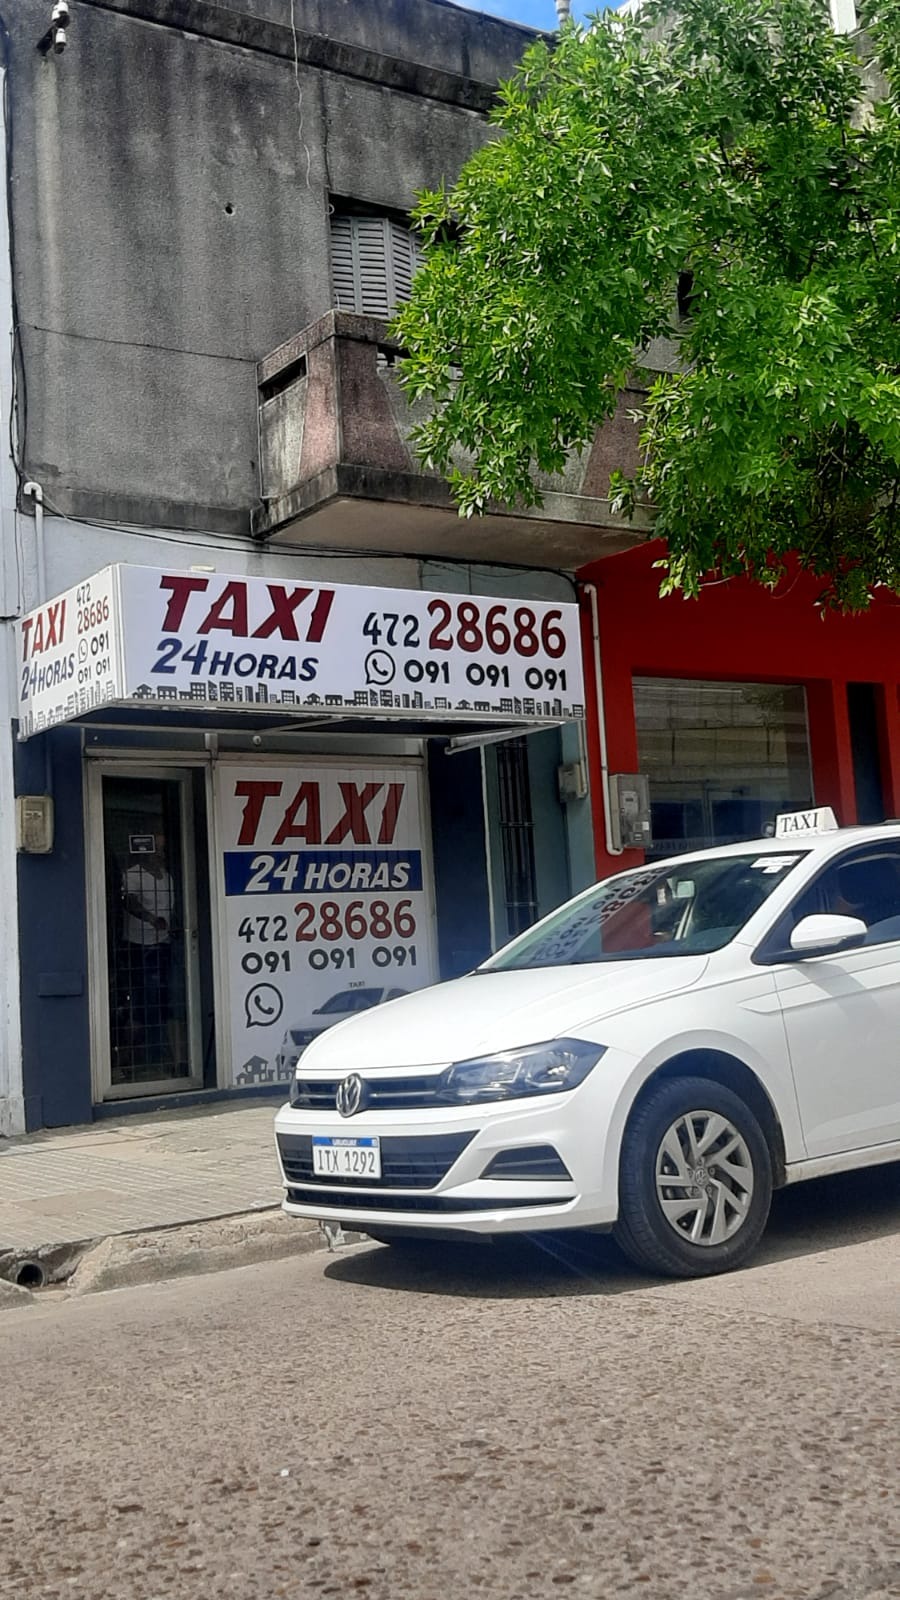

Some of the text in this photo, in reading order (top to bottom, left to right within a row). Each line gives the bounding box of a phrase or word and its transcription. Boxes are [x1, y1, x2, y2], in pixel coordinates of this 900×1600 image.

[76, 583, 91, 607] 472
[160, 575, 335, 643] TAXI
[22, 599, 66, 662] TAXI
[77, 596, 109, 634] 28686
[363, 599, 567, 659] 472 28686
[90, 631, 109, 655] 091
[77, 656, 111, 684] 091 091
[404, 659, 568, 691] 091 091 091
[234, 781, 405, 845] TAXI
[781, 812, 818, 832] TAXI
[244, 854, 411, 892] 24 HORAS
[238, 900, 416, 943] 472 28686
[241, 945, 417, 974] 091 091 091
[318, 1149, 375, 1174] ITX 1292
